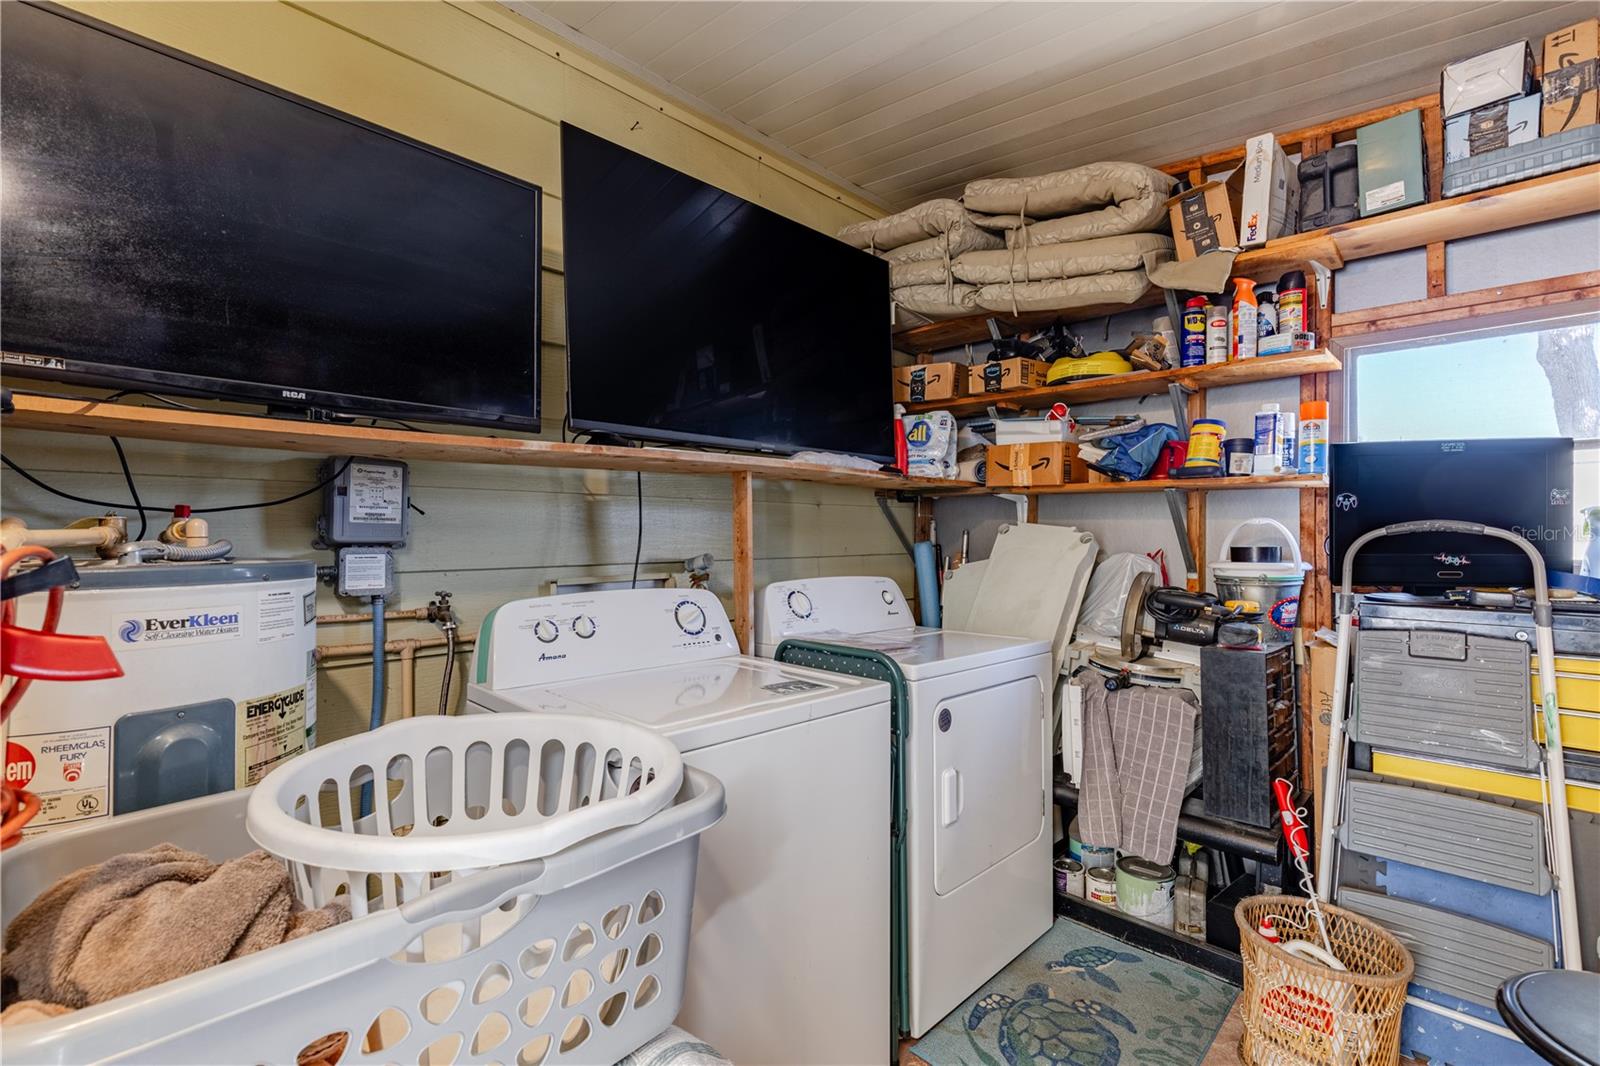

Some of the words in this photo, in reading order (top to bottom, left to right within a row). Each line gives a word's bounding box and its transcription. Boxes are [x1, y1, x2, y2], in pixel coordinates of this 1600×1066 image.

[1256, 140, 1264, 153] Box
[1253, 155, 1263, 183] Medium
[1247, 211, 1259, 242] FedEx
[282, 391, 306, 400] RCA
[908, 425, 927, 441] all
[145, 613, 239, 631] EverKleen
[1180, 626, 1206, 635] DELTA
[538, 652, 567, 662] Amana
[246, 689, 305, 719] ENERGYGUIDE
[41, 740, 106, 754] RHEEMGLAS
[60, 752, 88, 762] FURY
